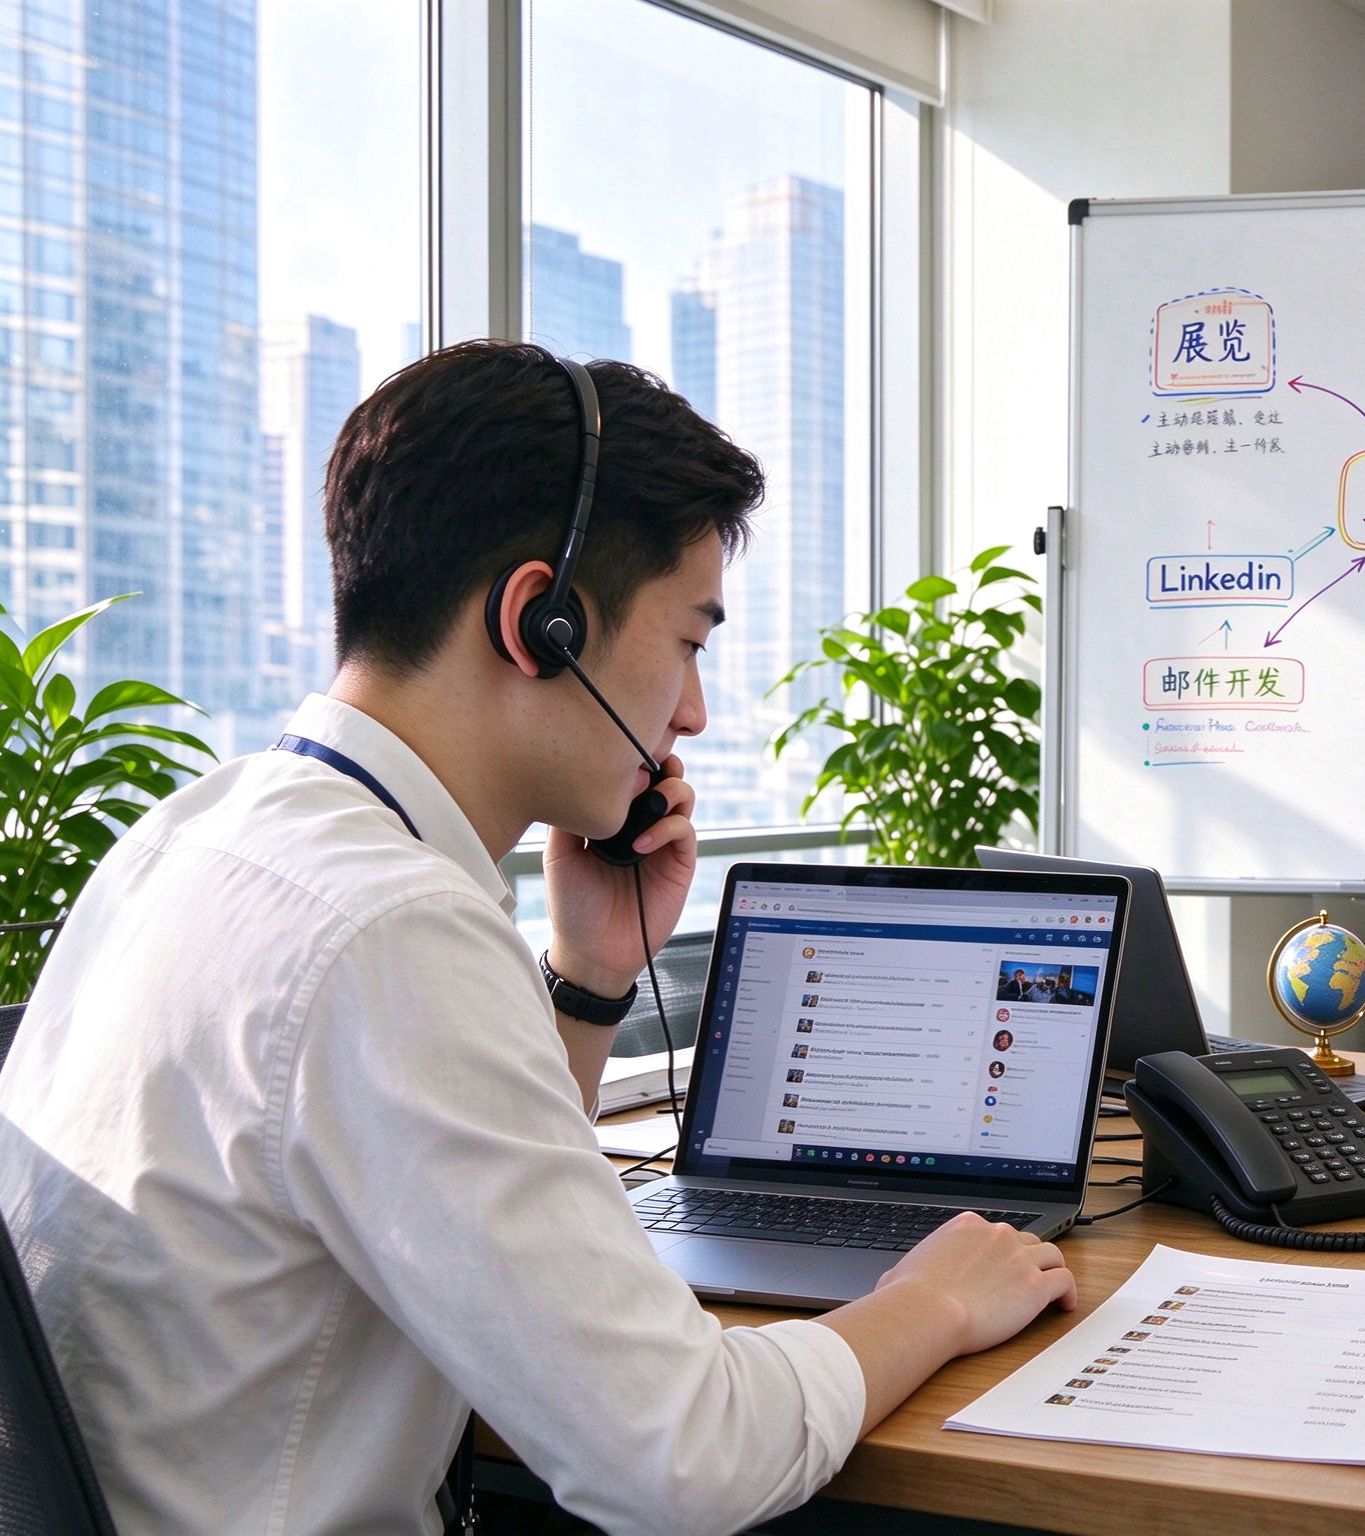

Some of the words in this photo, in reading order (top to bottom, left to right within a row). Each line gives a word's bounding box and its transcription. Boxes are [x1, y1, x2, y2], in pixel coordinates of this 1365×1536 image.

[1172, 318, 1251, 363] 展览
[1160, 561, 1281, 592] Linkedin
[1161, 666, 1287, 700] 邮件开发
